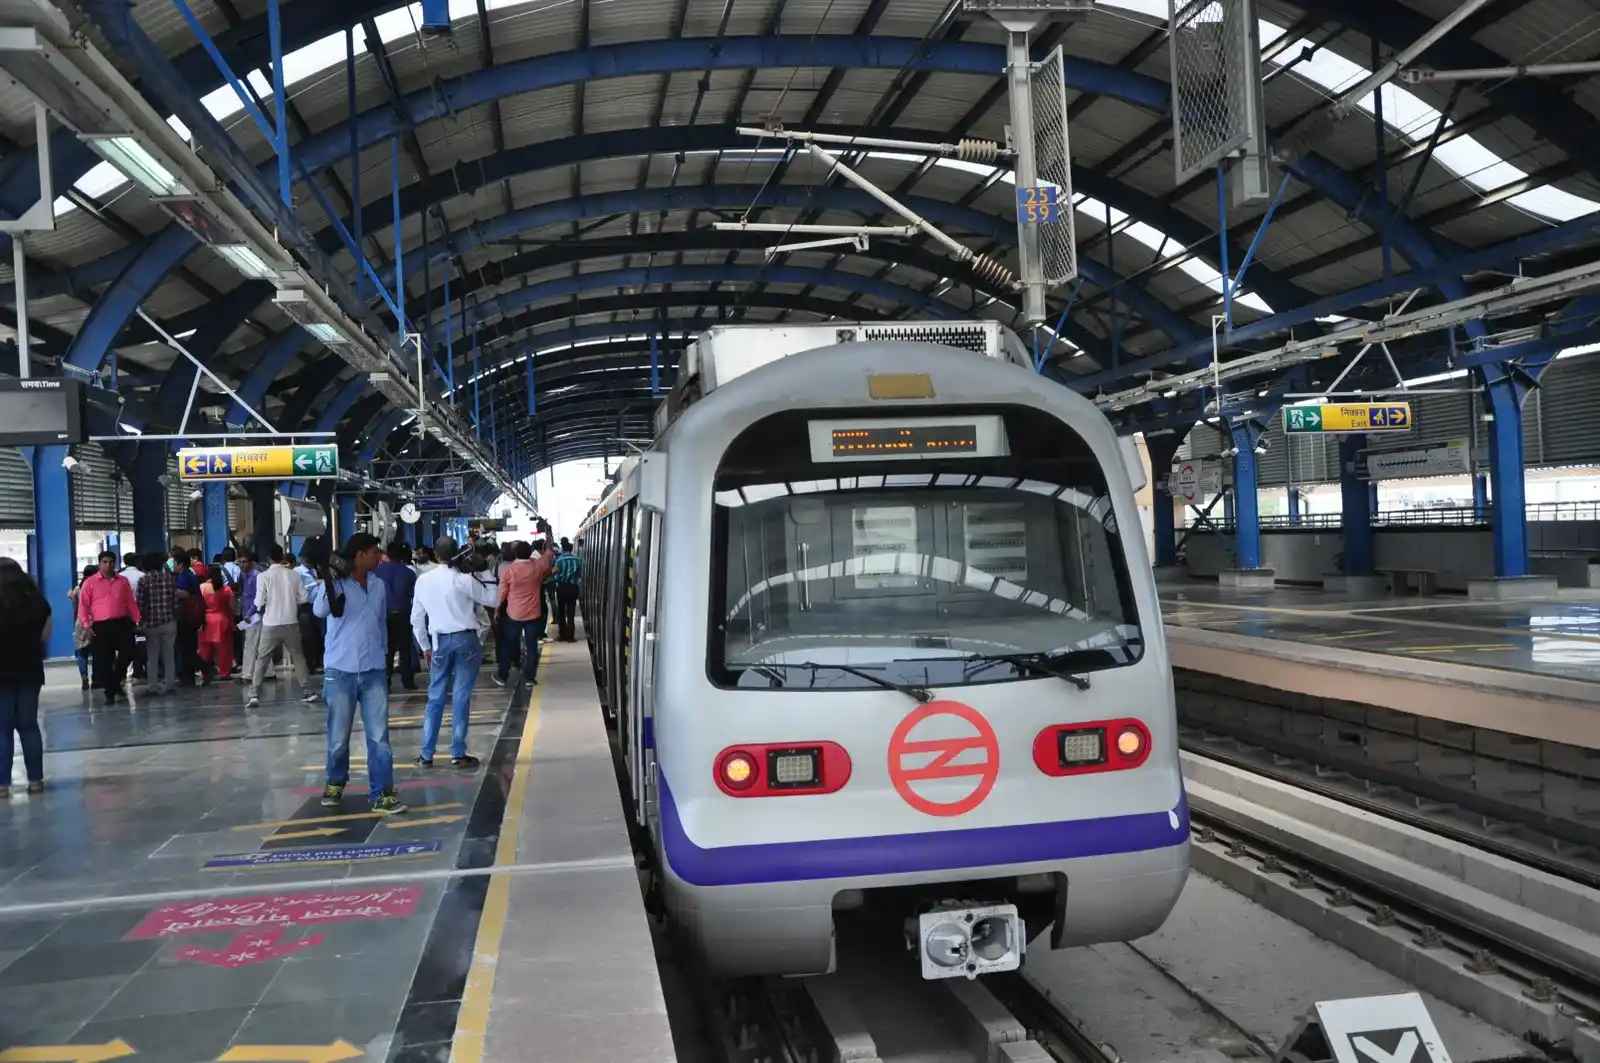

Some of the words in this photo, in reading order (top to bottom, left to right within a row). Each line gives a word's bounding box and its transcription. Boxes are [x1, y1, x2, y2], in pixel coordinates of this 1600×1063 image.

[1026, 187, 1048, 203] 25
[1027, 205, 1050, 222] 59
[234, 465, 255, 474] Exit
[289, 891, 391, 906] Women
[180, 901, 266, 918] Only
